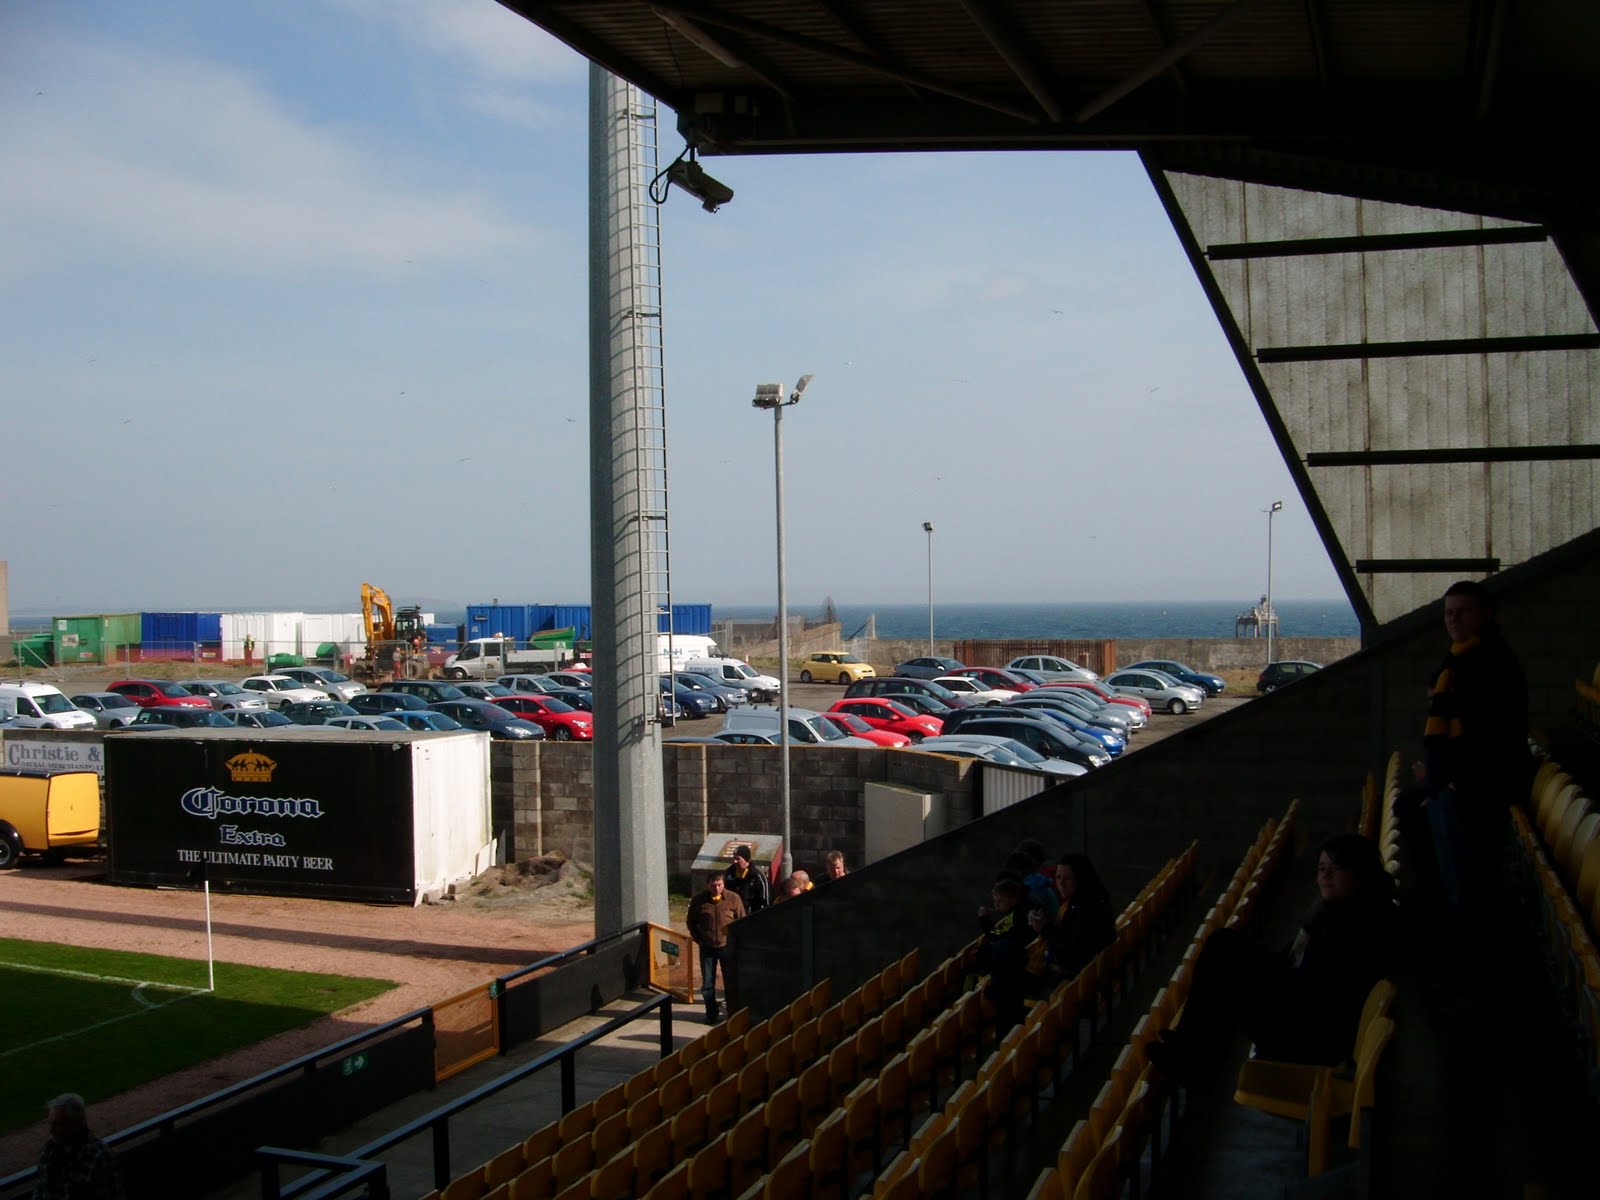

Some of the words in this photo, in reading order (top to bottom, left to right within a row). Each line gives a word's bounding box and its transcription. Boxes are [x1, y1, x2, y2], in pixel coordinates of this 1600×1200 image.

[9, 744, 79, 766] Christie
[88, 746, 101, 762] &
[181, 785, 325, 819] Corona
[219, 824, 286, 847] Extra
[177, 849, 201, 863] THE
[203, 851, 261, 866] ULTIMATE
[263, 854, 299, 869] PARTY
[302, 856, 334, 870] BEER
